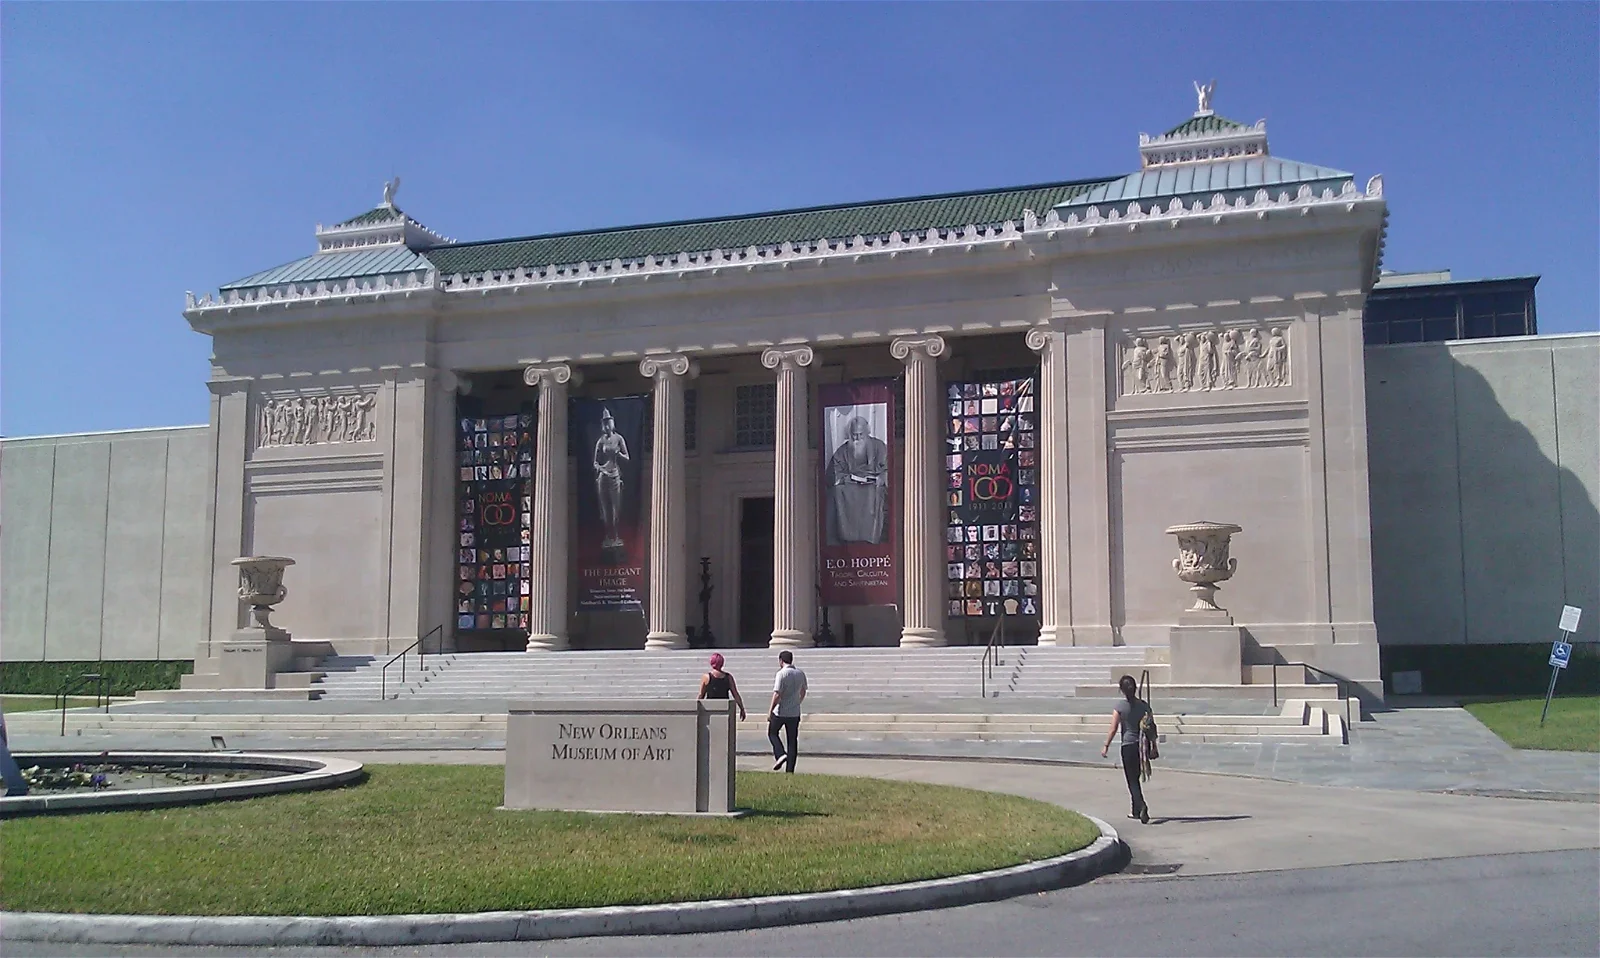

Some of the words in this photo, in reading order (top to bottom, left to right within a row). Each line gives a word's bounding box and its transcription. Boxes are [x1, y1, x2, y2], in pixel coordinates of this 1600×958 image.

[967, 463, 1011, 476] NOMA
[968, 475, 1013, 501] 100
[478, 492, 513, 502] NOMA
[479, 503, 516, 526] 100
[851, 554, 891, 568] HOPPÉ
[584, 568, 601, 577] THE
[604, 567, 641, 577] ELEGANT
[600, 577, 627, 586] IMAGE
[558, 723, 595, 740] NEW
[599, 723, 667, 740] ORLEANS
[551, 743, 617, 760] MUSEUM
[620, 747, 640, 760] OF
[643, 744, 674, 761] ART
